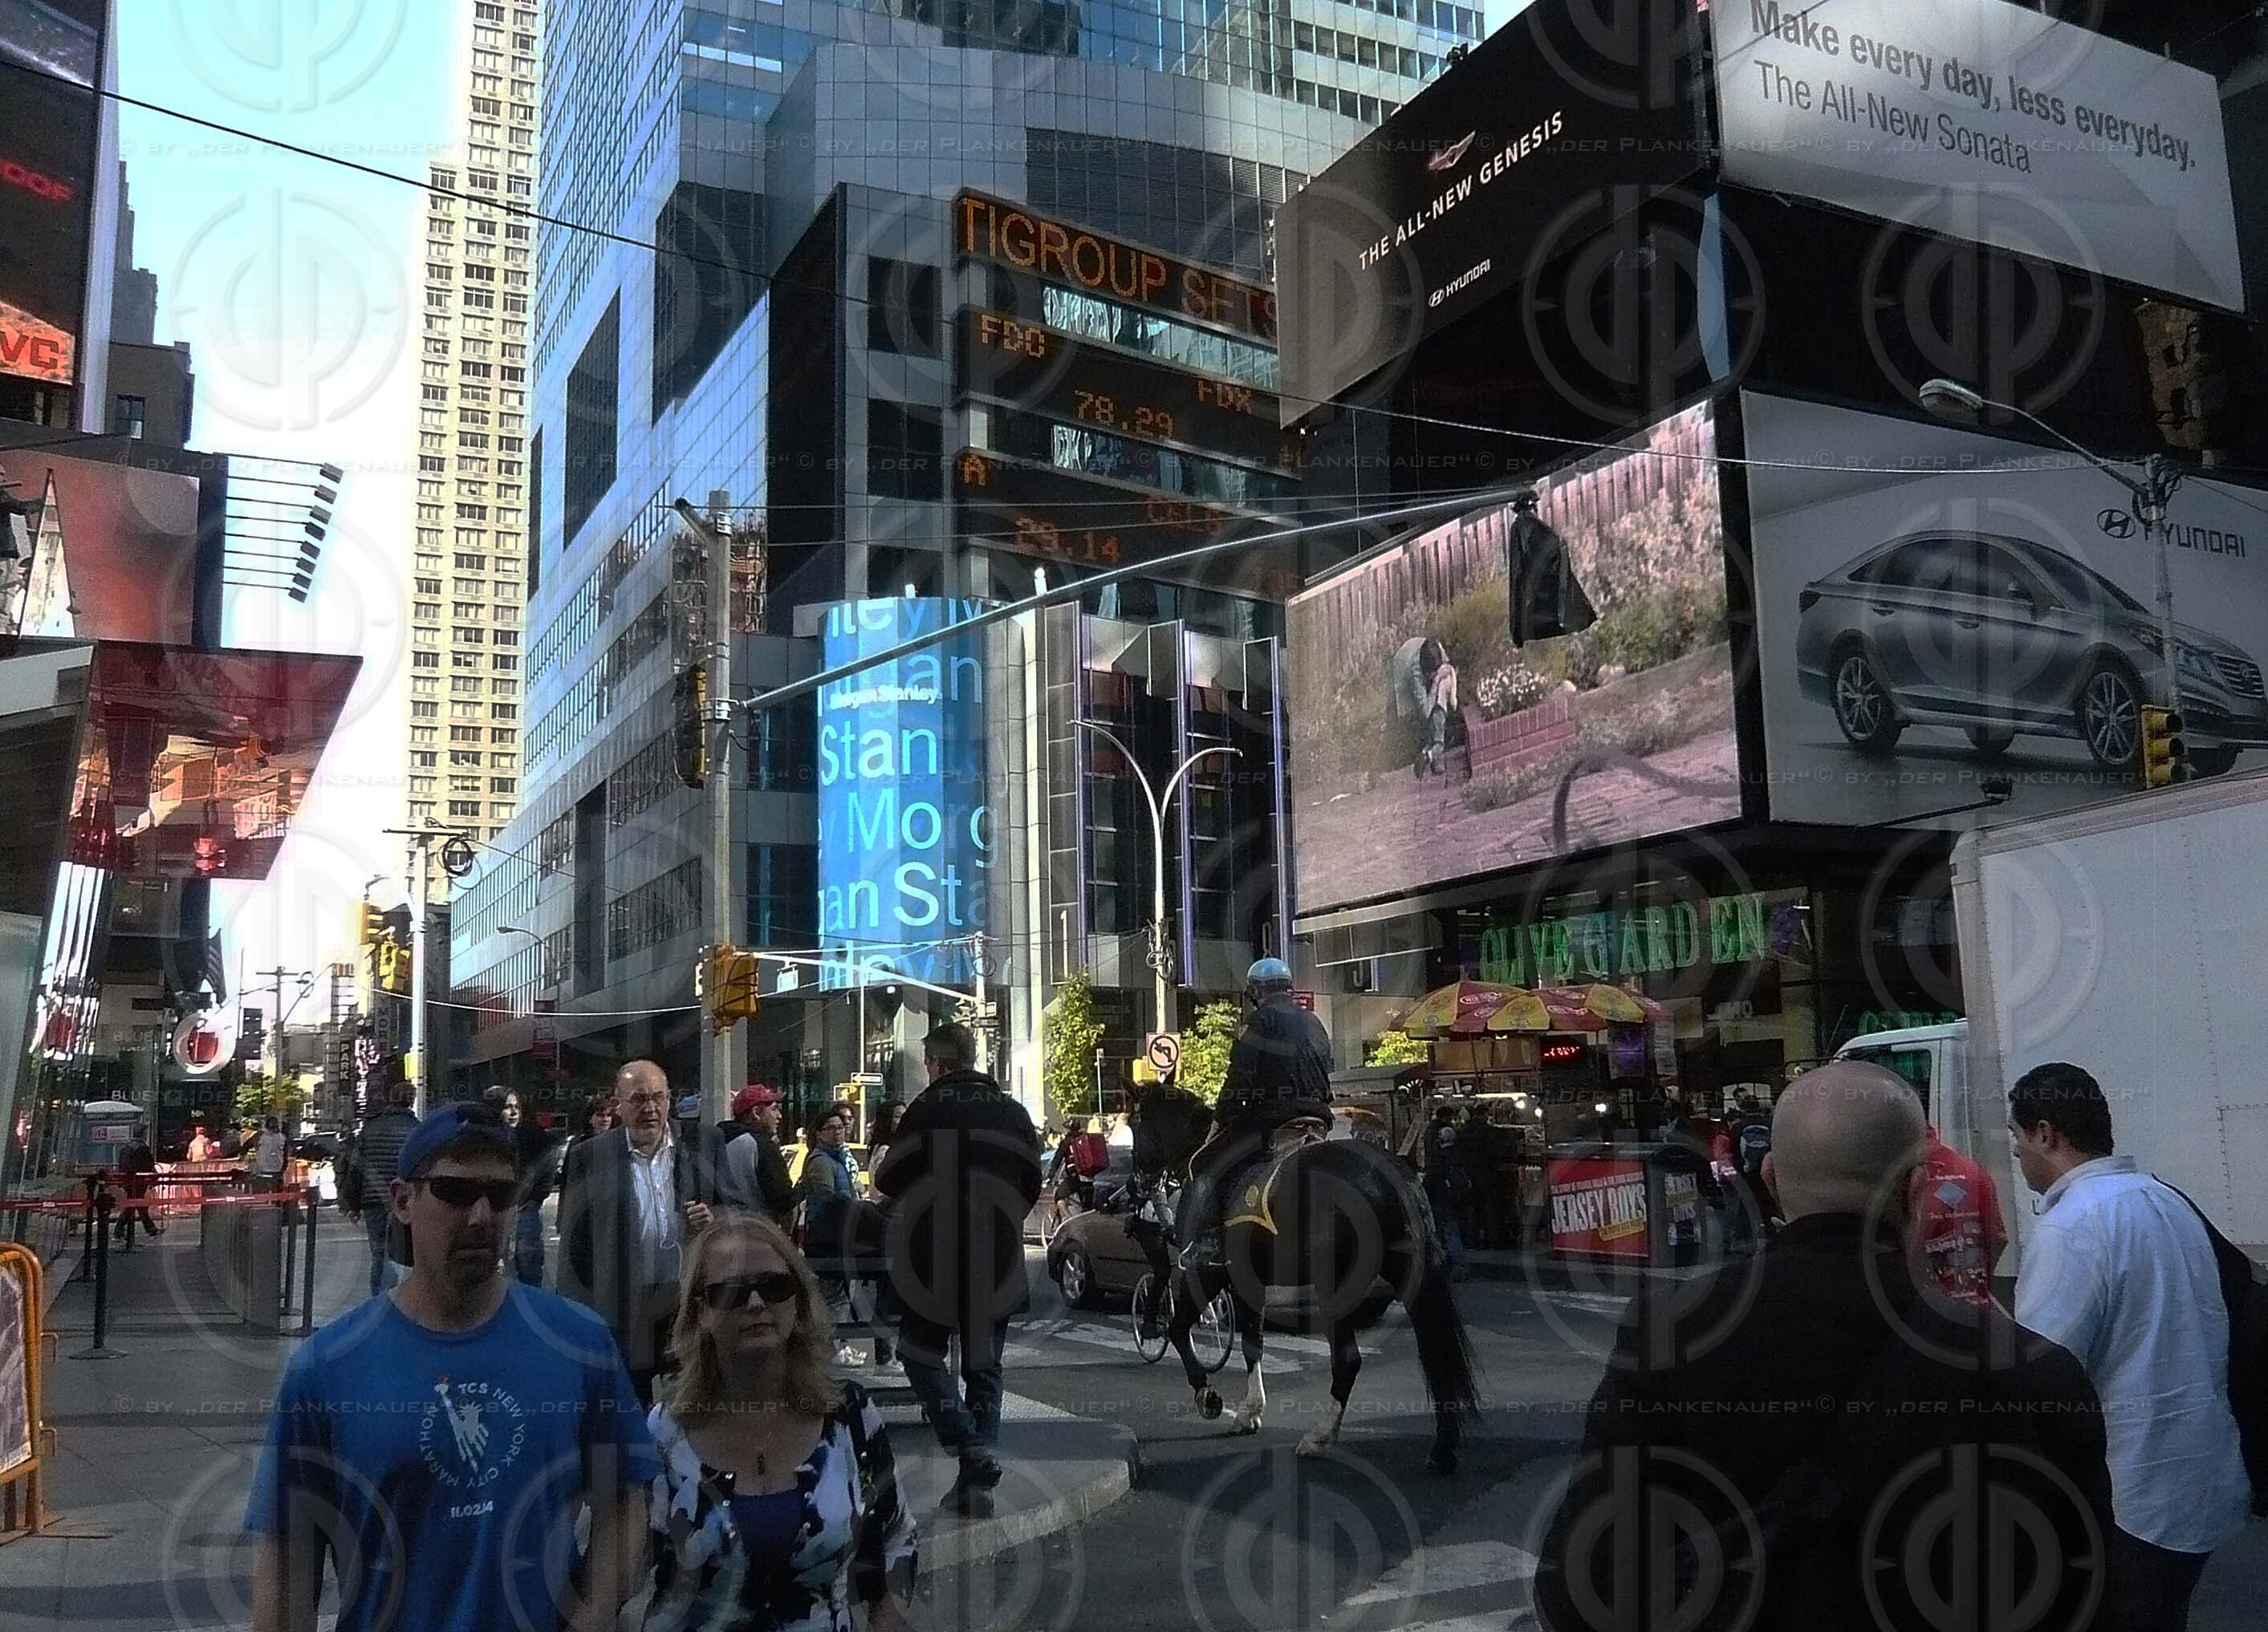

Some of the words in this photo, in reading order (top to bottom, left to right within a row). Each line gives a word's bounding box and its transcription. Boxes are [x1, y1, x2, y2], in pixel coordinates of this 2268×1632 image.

[1751, 0, 1839, 56] Make
[1849, 35, 1933, 91] every
[1942, 58, 2001, 113] day,
[2009, 75, 2067, 126] less
[2075, 104, 2196, 172] everyday.
[1754, 59, 1812, 111] The
[1821, 79, 1929, 143] All-New
[1937, 113, 2031, 174] Sonata
[1359, 241, 1390, 270] THE
[1396, 176, 1473, 246] ALL-NEW
[1479, 110, 1564, 186] GENESIS
[962, 197, 1167, 302] TIGROUP
[1445, 258, 1491, 297] HYUNDAI
[821, 721, 937, 786] Stan
[1551, 1187, 1606, 1236] JERSEY
[457, 1381, 488, 1395] TCS
[492, 1386, 524, 1419] NEW
[418, 1404, 461, 1487] MARATHON
[500, 1423, 526, 1468] YORK
